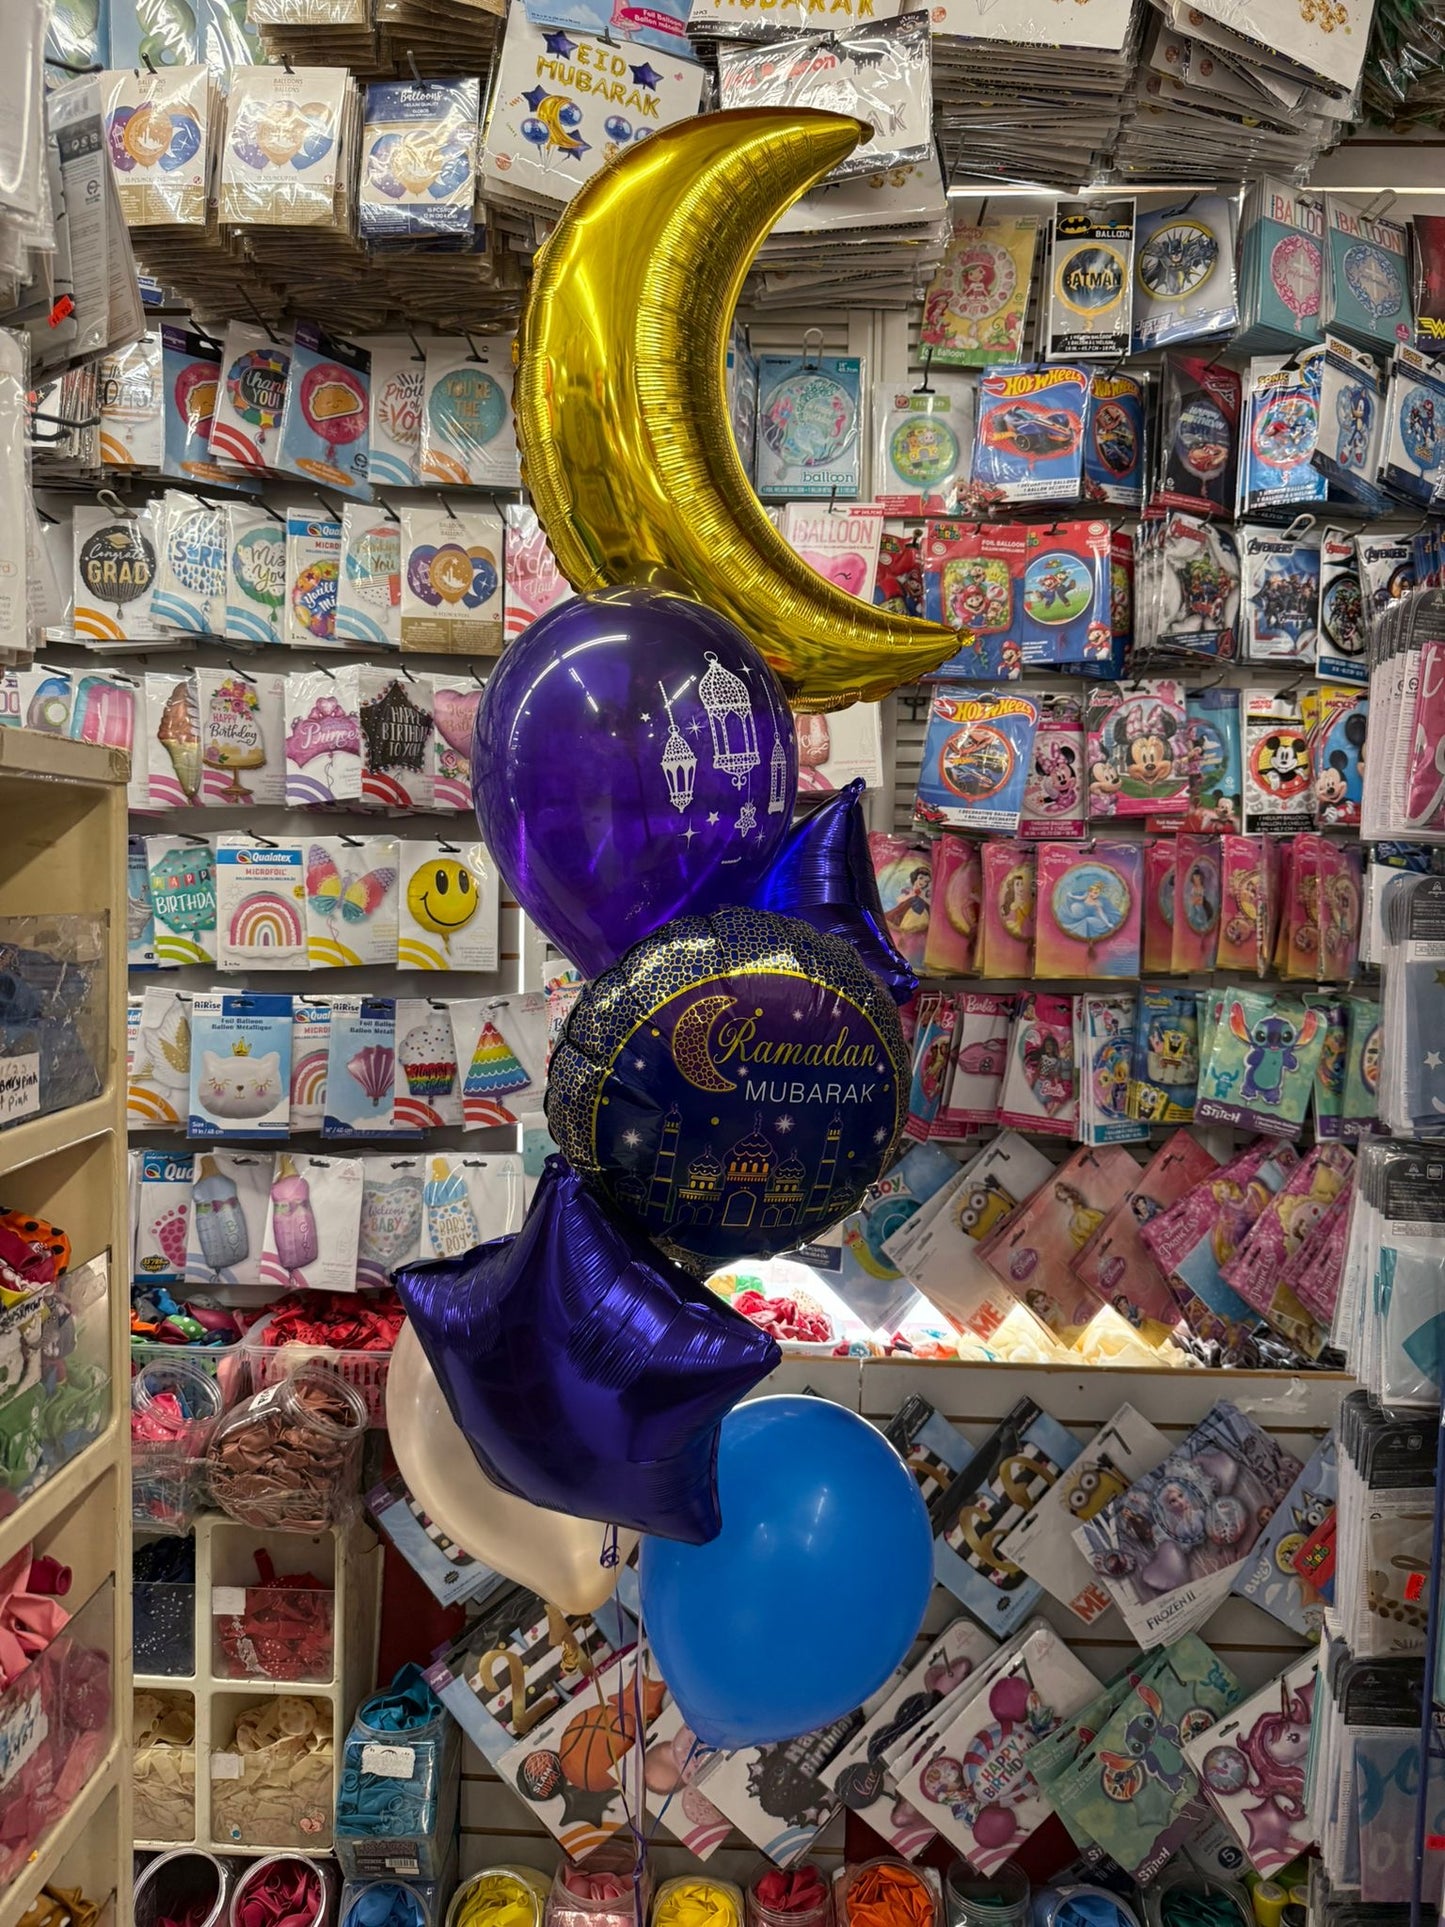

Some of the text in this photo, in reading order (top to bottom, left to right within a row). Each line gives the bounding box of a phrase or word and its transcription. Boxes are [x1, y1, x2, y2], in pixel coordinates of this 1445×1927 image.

[577, 43, 627, 77] EID
[400, 90, 443, 102] Balloons
[536, 55, 661, 119] MUBARAK
[1095, 230, 1130, 238] BALLOON
[1339, 210, 1404, 254] BALLOON
[1067, 269, 1121, 290] BATMAN
[454, 401, 481, 418] THE
[803, 472, 854, 483] balloon
[997, 540, 1026, 548] BALLOON
[1248, 536, 1294, 555] AVENGERS
[1364, 547, 1408, 564] AVENGERS
[87, 560, 150, 586] GRAD
[212, 713, 237, 724] HAPPY
[209, 723, 257, 745] Birthday
[252, 851, 293, 863] Qualatex
[245, 868, 287, 876] MICROFOIL
[194, 1000, 222, 1009] AiRise
[333, 1002, 360, 1011] AiRise
[966, 995, 997, 1013] Barbie
[713, 1016, 880, 1067] Ramadan
[745, 1080, 876, 1104] MUBARAK
[1040, 1079, 1066, 1097] Barbie
[870, 1176, 900, 1200] BOY
[371, 1216, 403, 1234] BABY
[438, 1216, 467, 1236] BABY
[445, 1234, 468, 1253] BOY
[967, 1302, 1007, 1341] ME
[1073, 1586, 1112, 1622] ME
[1146, 1599, 1189, 1631] FROZEN
[980, 1739, 1019, 1783] HAPPY
[533, 1767, 552, 1794] SLAM
